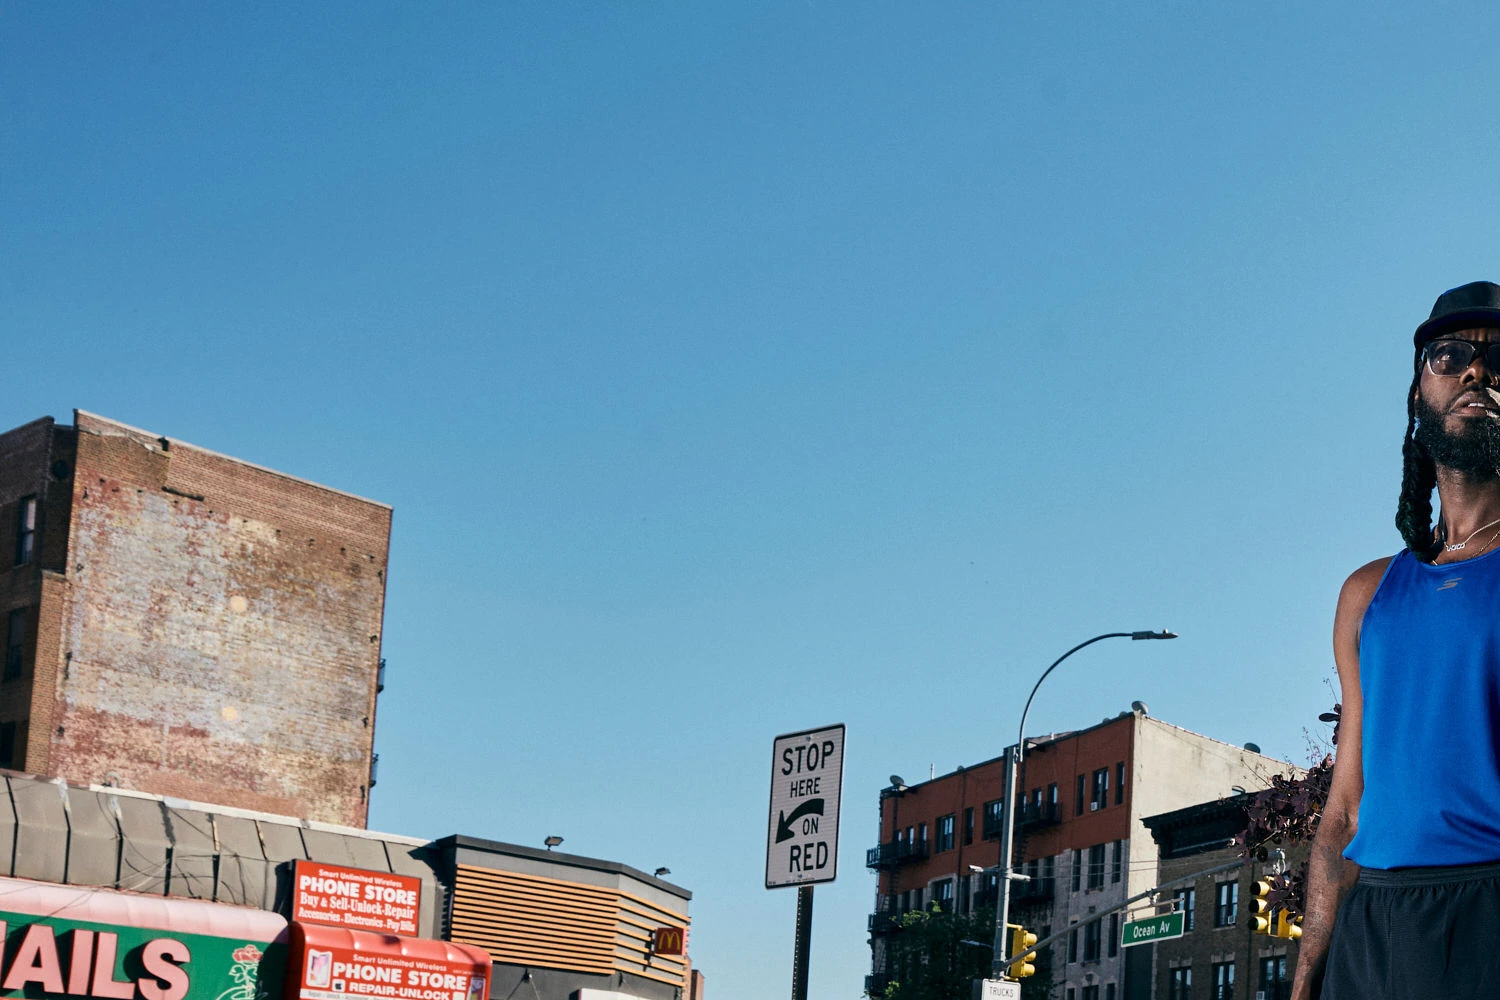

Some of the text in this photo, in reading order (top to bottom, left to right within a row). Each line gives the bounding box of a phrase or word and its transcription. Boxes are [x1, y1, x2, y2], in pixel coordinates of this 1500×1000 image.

[781, 740, 835, 776] STOP
[789, 777, 821, 798] HERE
[802, 817, 819, 836] ON
[789, 841, 829, 873] RED
[319, 869, 402, 888] Smart Unlimited Wireless
[299, 875, 417, 906] PHONE STORE
[300, 892, 319, 908] Buy
[1133, 920, 1171, 939] Ocean Av
[353, 954, 447, 972] Smart Unlimited Wireless
[332, 962, 467, 991] PHONE STORE
[989, 986, 1014, 998] TRUCKS
